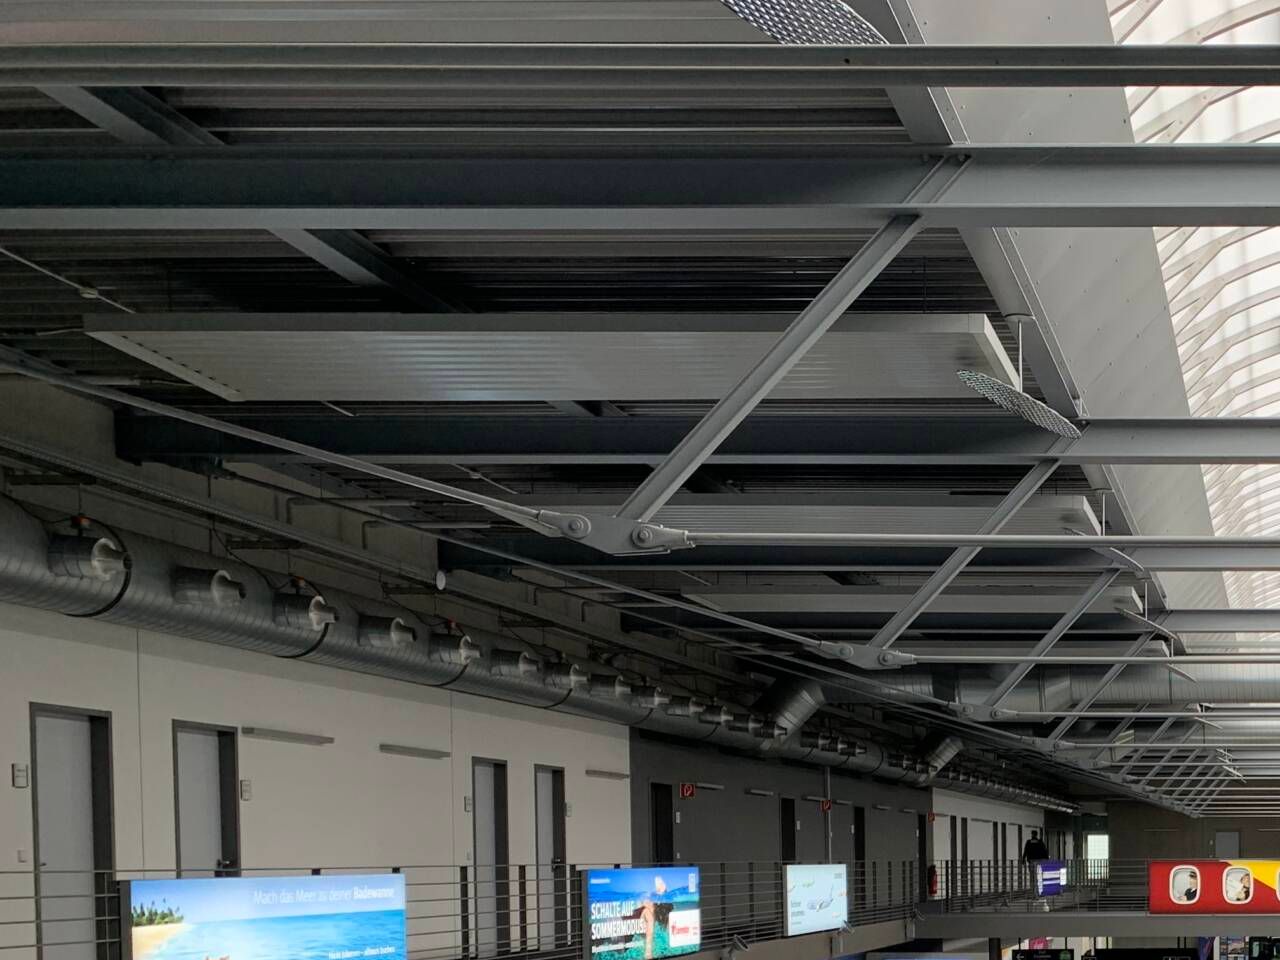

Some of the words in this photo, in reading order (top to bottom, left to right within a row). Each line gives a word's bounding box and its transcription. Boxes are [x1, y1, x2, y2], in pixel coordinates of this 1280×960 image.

[254, 889, 278, 904] Mach
[353, 885, 394, 899] Badewanne
[591, 901, 621, 919] SCHALTE
[621, 900, 634, 916] AUF
